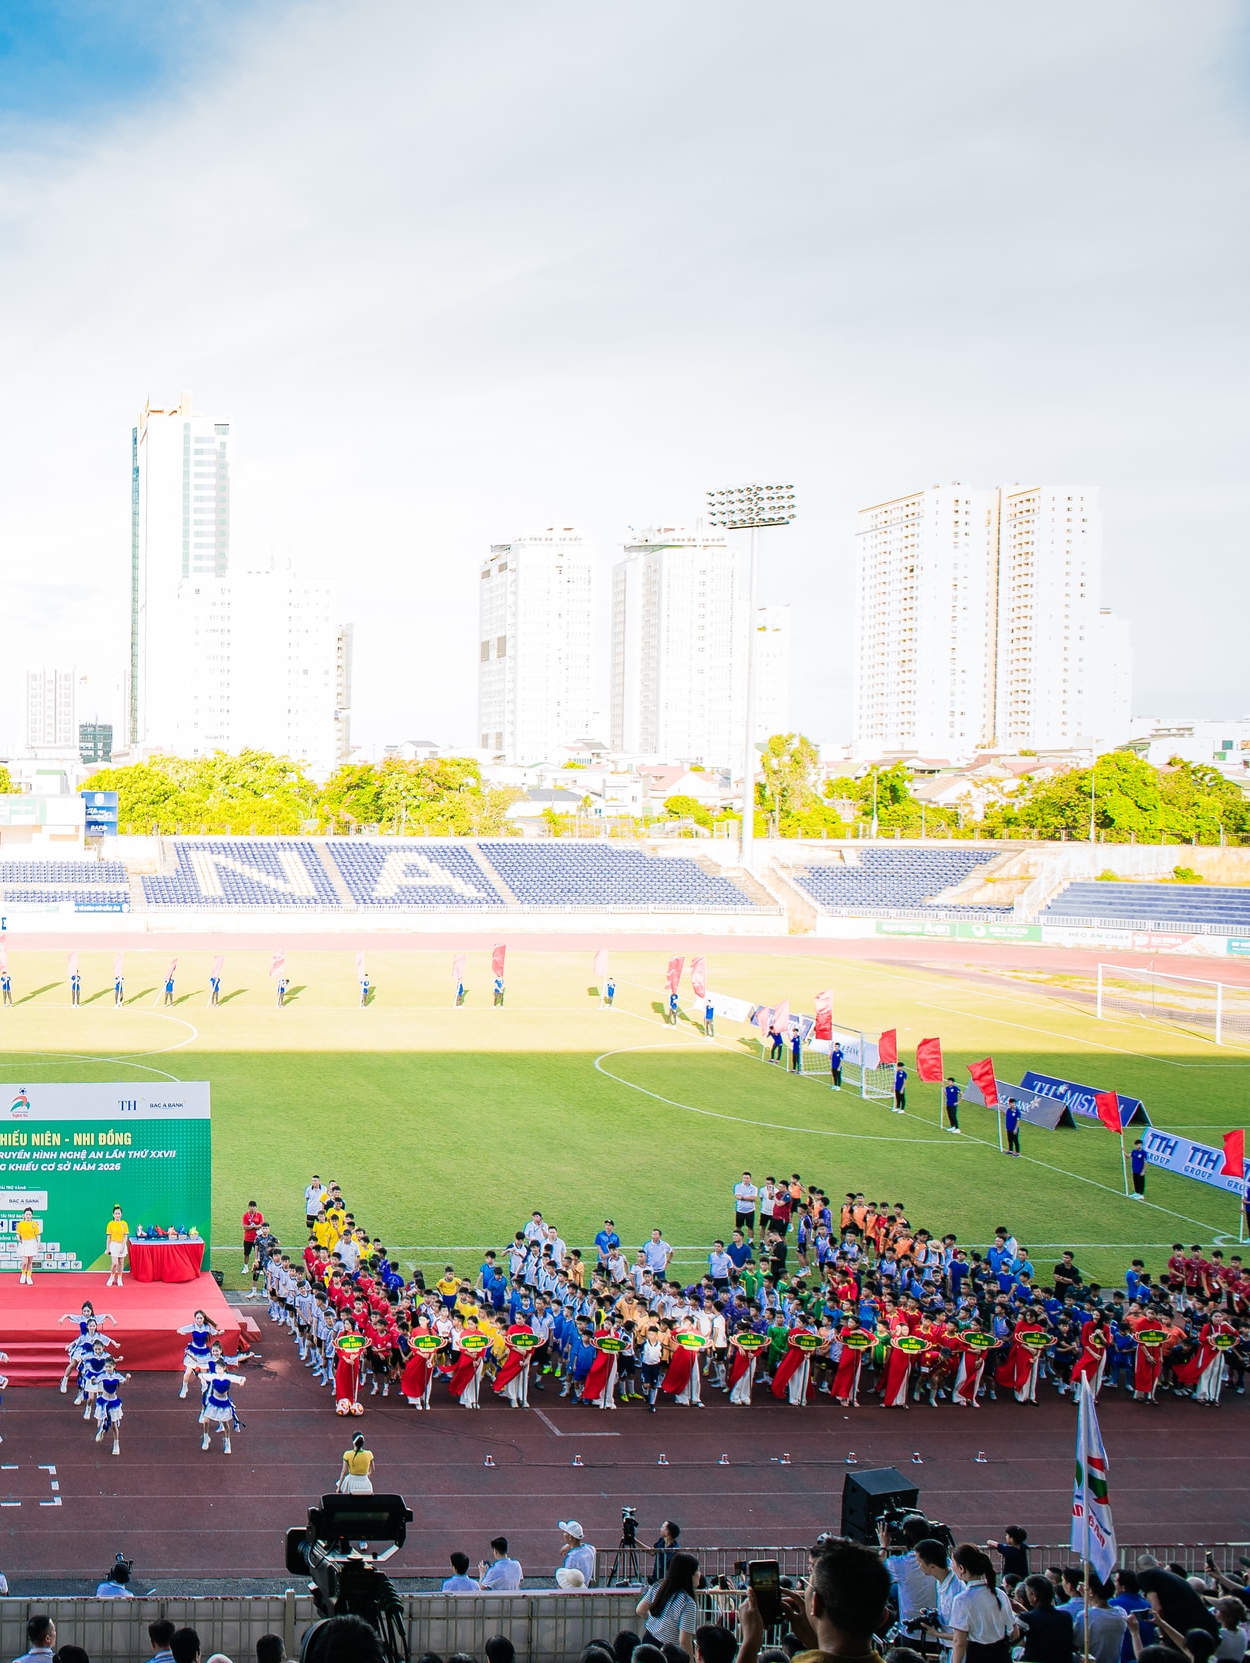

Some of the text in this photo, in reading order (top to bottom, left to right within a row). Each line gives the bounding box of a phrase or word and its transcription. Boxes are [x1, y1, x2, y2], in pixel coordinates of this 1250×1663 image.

[118, 1100, 137, 1111] TH
[32, 1130, 61, 1146] NIÊN
[73, 1132, 94, 1146] NHI
[99, 1129, 132, 1146] ĐỒNG
[1147, 1132, 1178, 1157] TTH
[33, 1149, 57, 1159] HÌNH
[59, 1149, 87, 1161] NGHỆ
[105, 1149, 125, 1159] LẦN
[128, 1149, 148, 1158] THỨ
[149, 1150, 176, 1158] XXVII
[1188, 1146, 1222, 1171] TTH
[8, 1161, 38, 1171] KHIẾU
[41, 1162, 56, 1171] CƠ
[57, 1161, 71, 1171] SỞ
[73, 1161, 96, 1171] NĂM
[97, 1163, 121, 1171] 2026
[1183, 1165, 1213, 1180] GROUP
